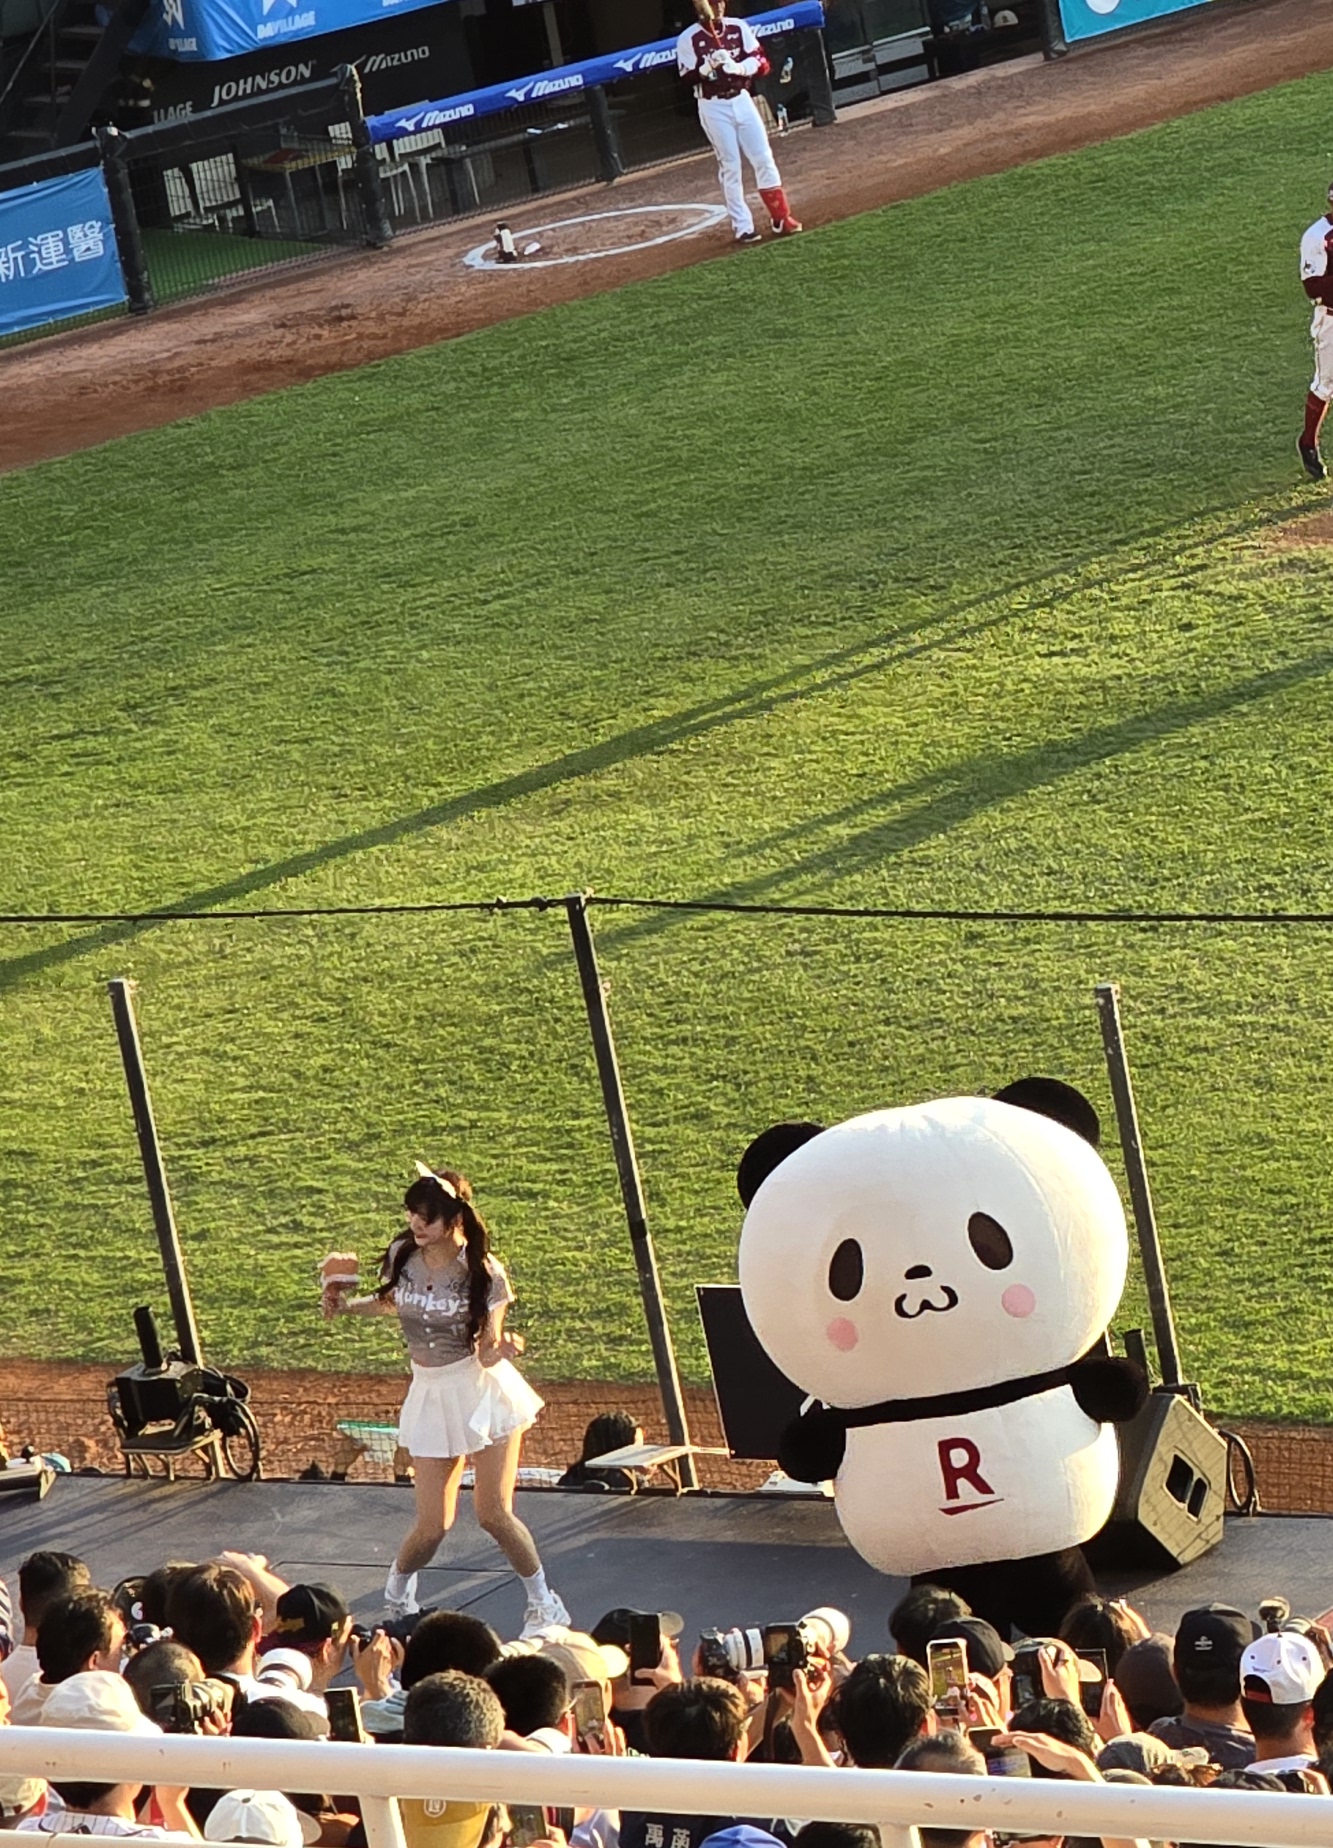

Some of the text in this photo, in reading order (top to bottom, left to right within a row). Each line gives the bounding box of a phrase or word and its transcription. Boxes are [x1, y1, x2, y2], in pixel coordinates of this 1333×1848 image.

[211, 61, 313, 107] JOHNSON
[0, 220, 104, 283] 新運醫
[937, 1437, 995, 1501] R
